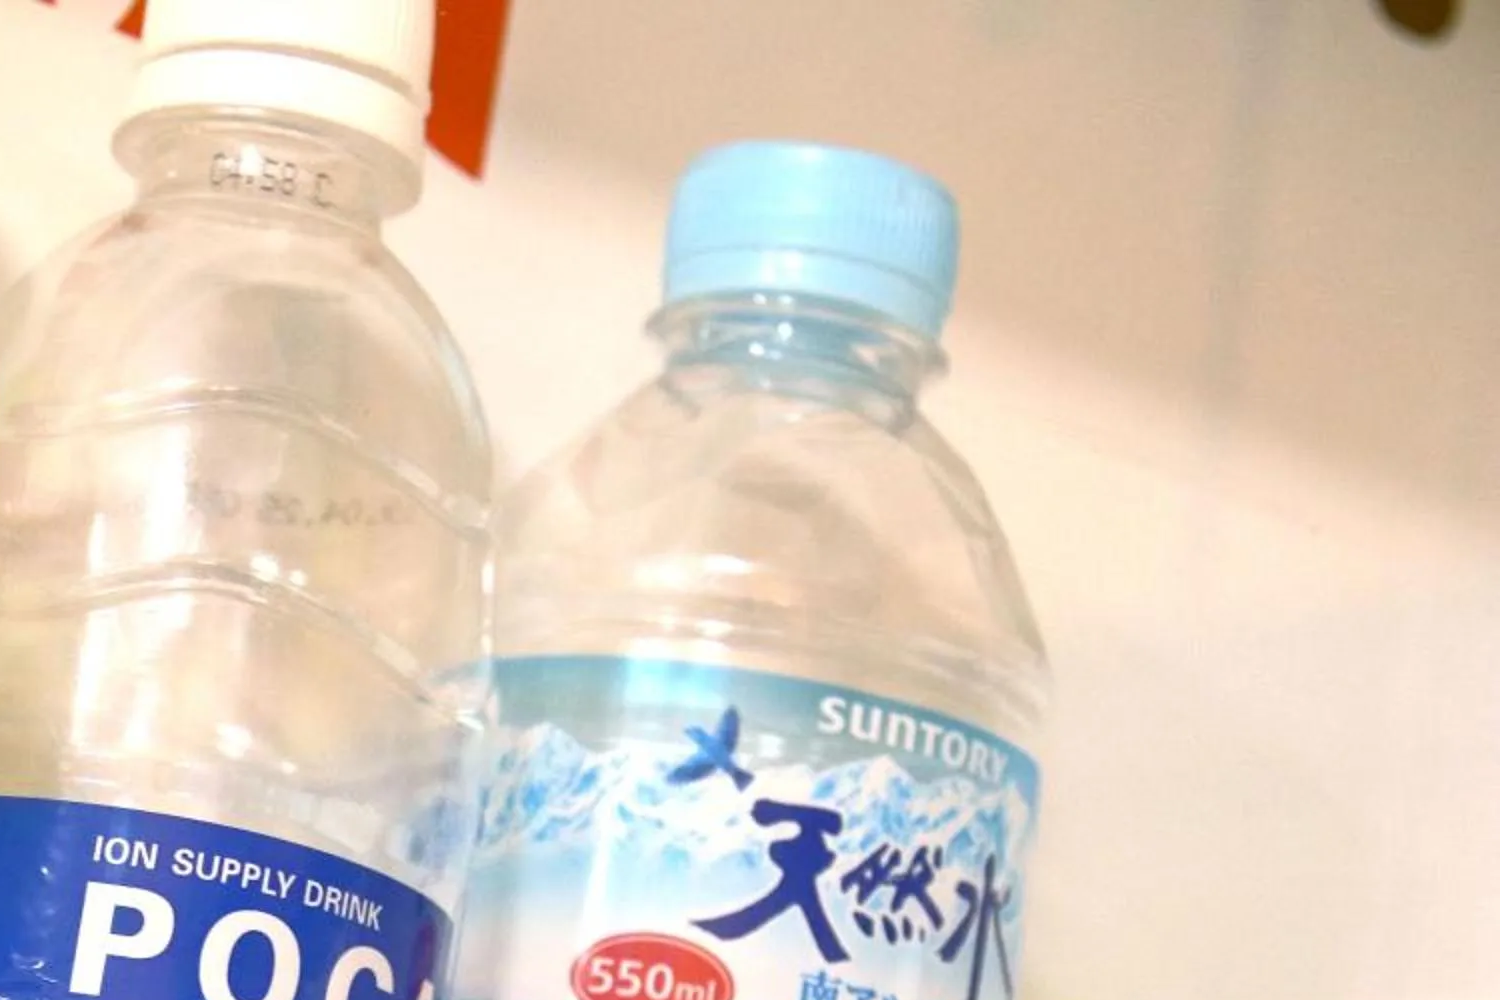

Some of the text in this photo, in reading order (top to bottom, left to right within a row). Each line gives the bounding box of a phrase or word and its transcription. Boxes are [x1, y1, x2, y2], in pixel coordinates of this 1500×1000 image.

[816, 695, 1010, 786] SUNTORY
[92, 834, 385, 933] ION SUPPLY DRINK
